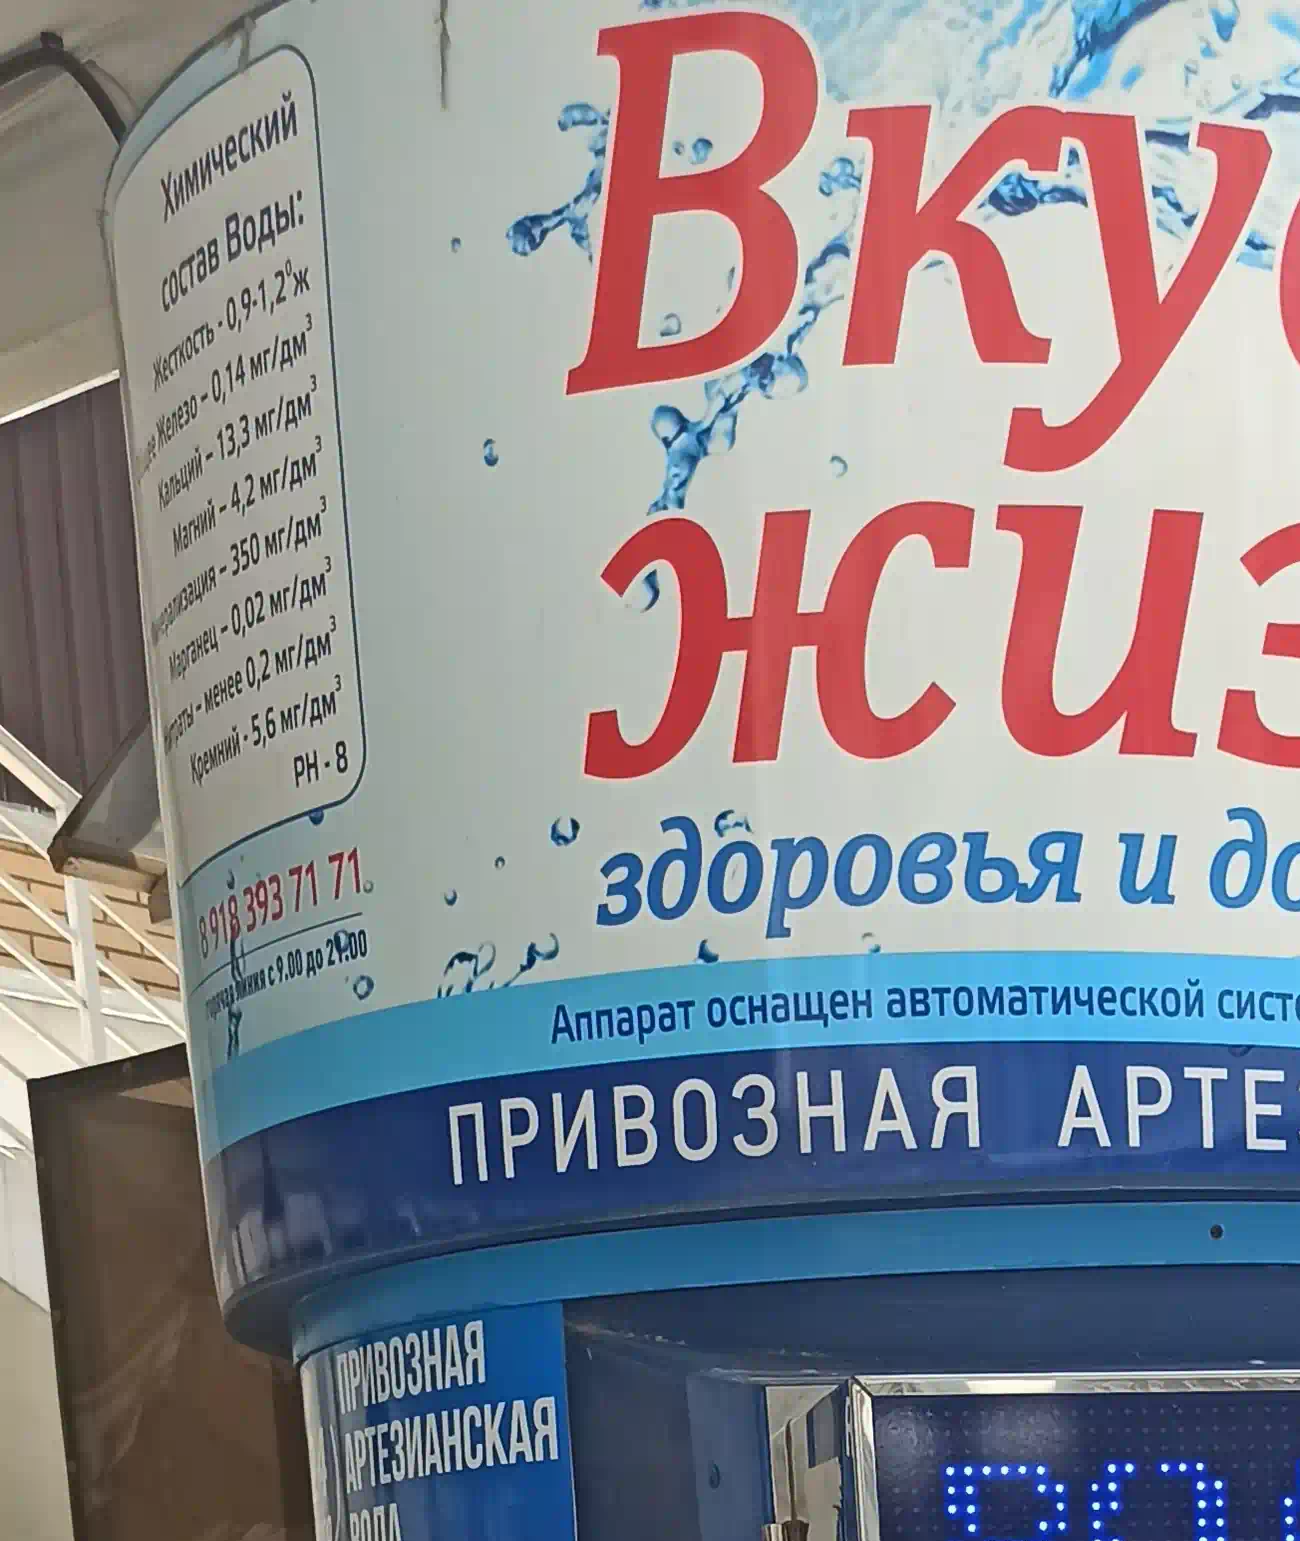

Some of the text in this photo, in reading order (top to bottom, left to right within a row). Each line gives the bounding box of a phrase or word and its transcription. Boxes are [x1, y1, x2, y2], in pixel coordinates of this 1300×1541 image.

[160, 89, 299, 224] Химический
[160, 189, 305, 313] состав Воды:
[210, 353, 246, 406] 0,14
[216, 413, 251, 461] 13,3
[230, 472, 256, 517] 4,2
[229, 531, 261, 577] 350
[230, 590, 266, 638] 0,02
[203, 648, 272, 715] менее 0,2
[250, 705, 277, 749] 5,6
[334, 740, 349, 774] 8
[208, 893, 241, 952] 918
[242, 873, 285, 933] 393
[288, 859, 319, 914] 71
[327, 845, 361, 900] 71
[597, 816, 1081, 941] здоровья
[1116, 828, 1178, 906] и
[276, 948, 304, 984] 9.00
[306, 947, 324, 980] до
[550, 994, 695, 1048] Аппарат
[706, 987, 874, 1036] оснащен
[886, 976, 1205, 1030] автоматической
[448, 1064, 982, 1188] ПРИВОЗНАЯ
[336, 1319, 486, 1416] ПРИВОЗНАЯ
[344, 1396, 560, 1495] АРТЕЗИАНСКАЯ
